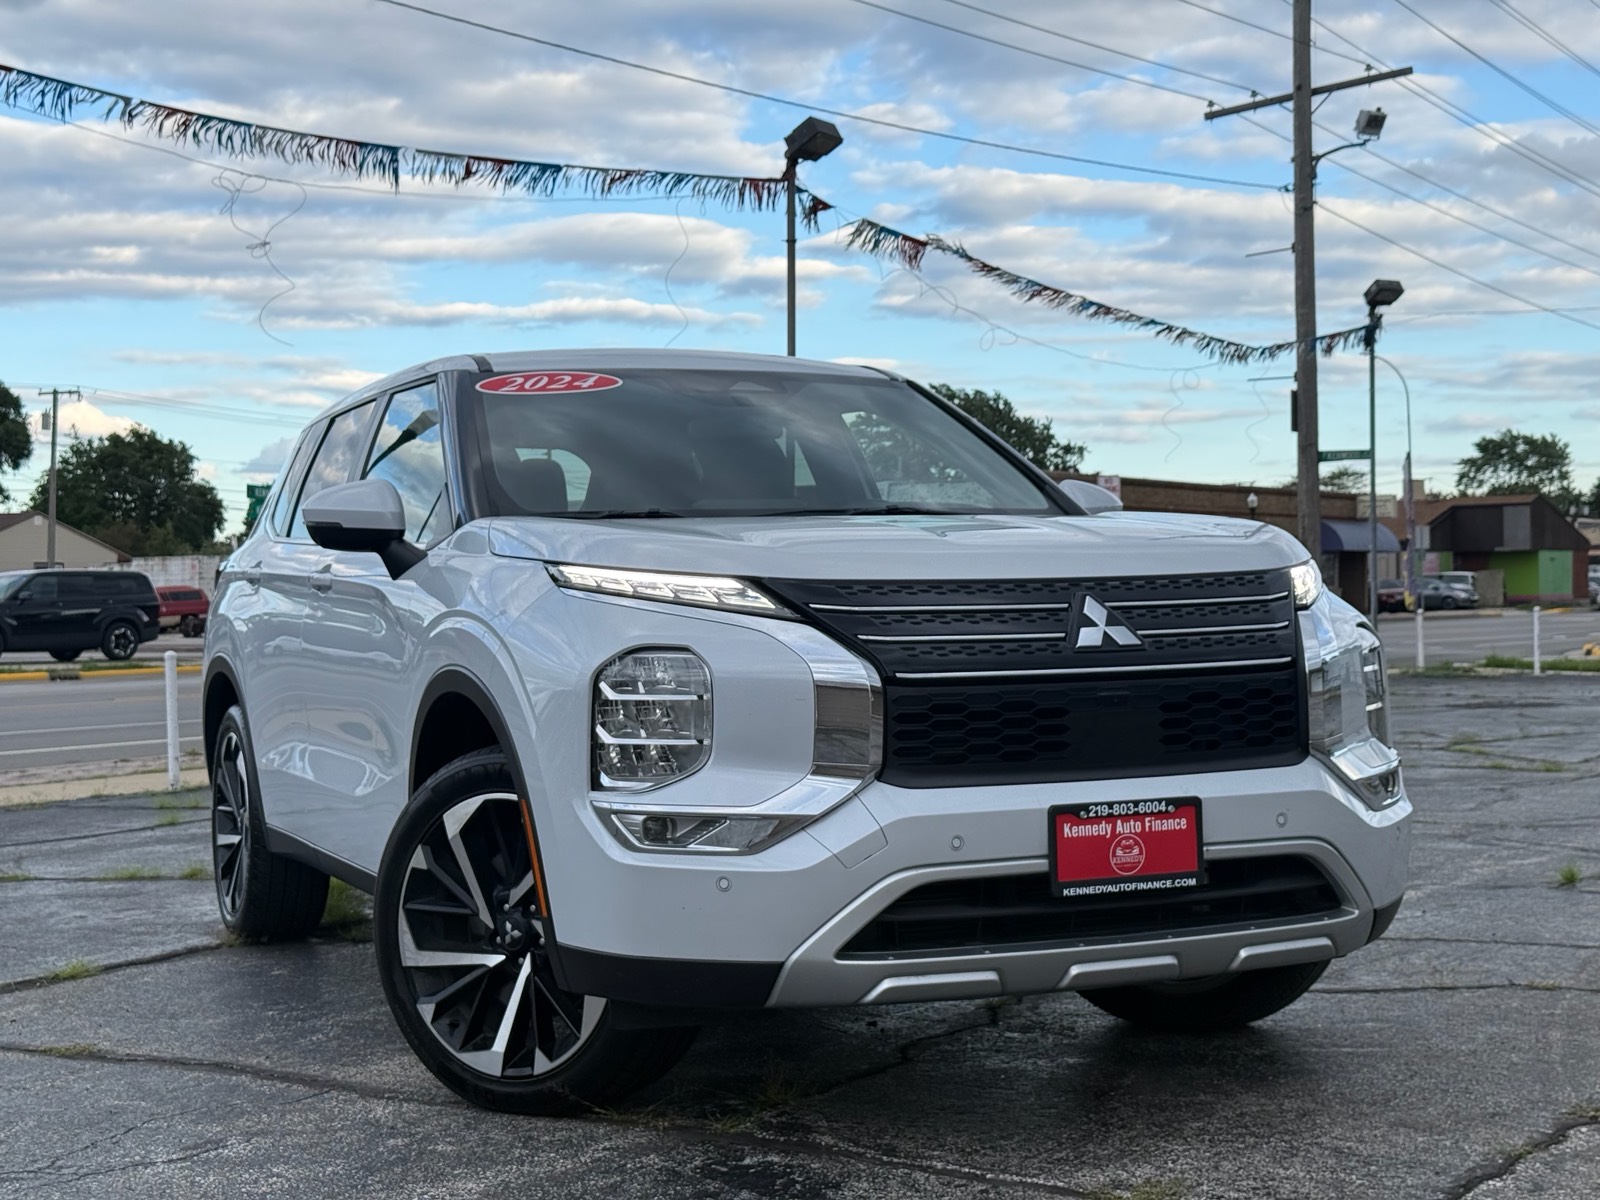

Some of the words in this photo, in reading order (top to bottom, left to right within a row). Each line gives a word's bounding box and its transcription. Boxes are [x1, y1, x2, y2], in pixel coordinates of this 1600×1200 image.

[498, 375, 600, 392] 2024
[1088, 800, 1166, 818] 219-803-6004
[1063, 822, 1112, 838] Kennedy
[1116, 819, 1141, 834] Auto
[1145, 816, 1187, 832] Finance
[1112, 854, 1143, 864] KENNEDY
[1063, 877, 1196, 896] KENNEDYAUTOFINANCE.COM
